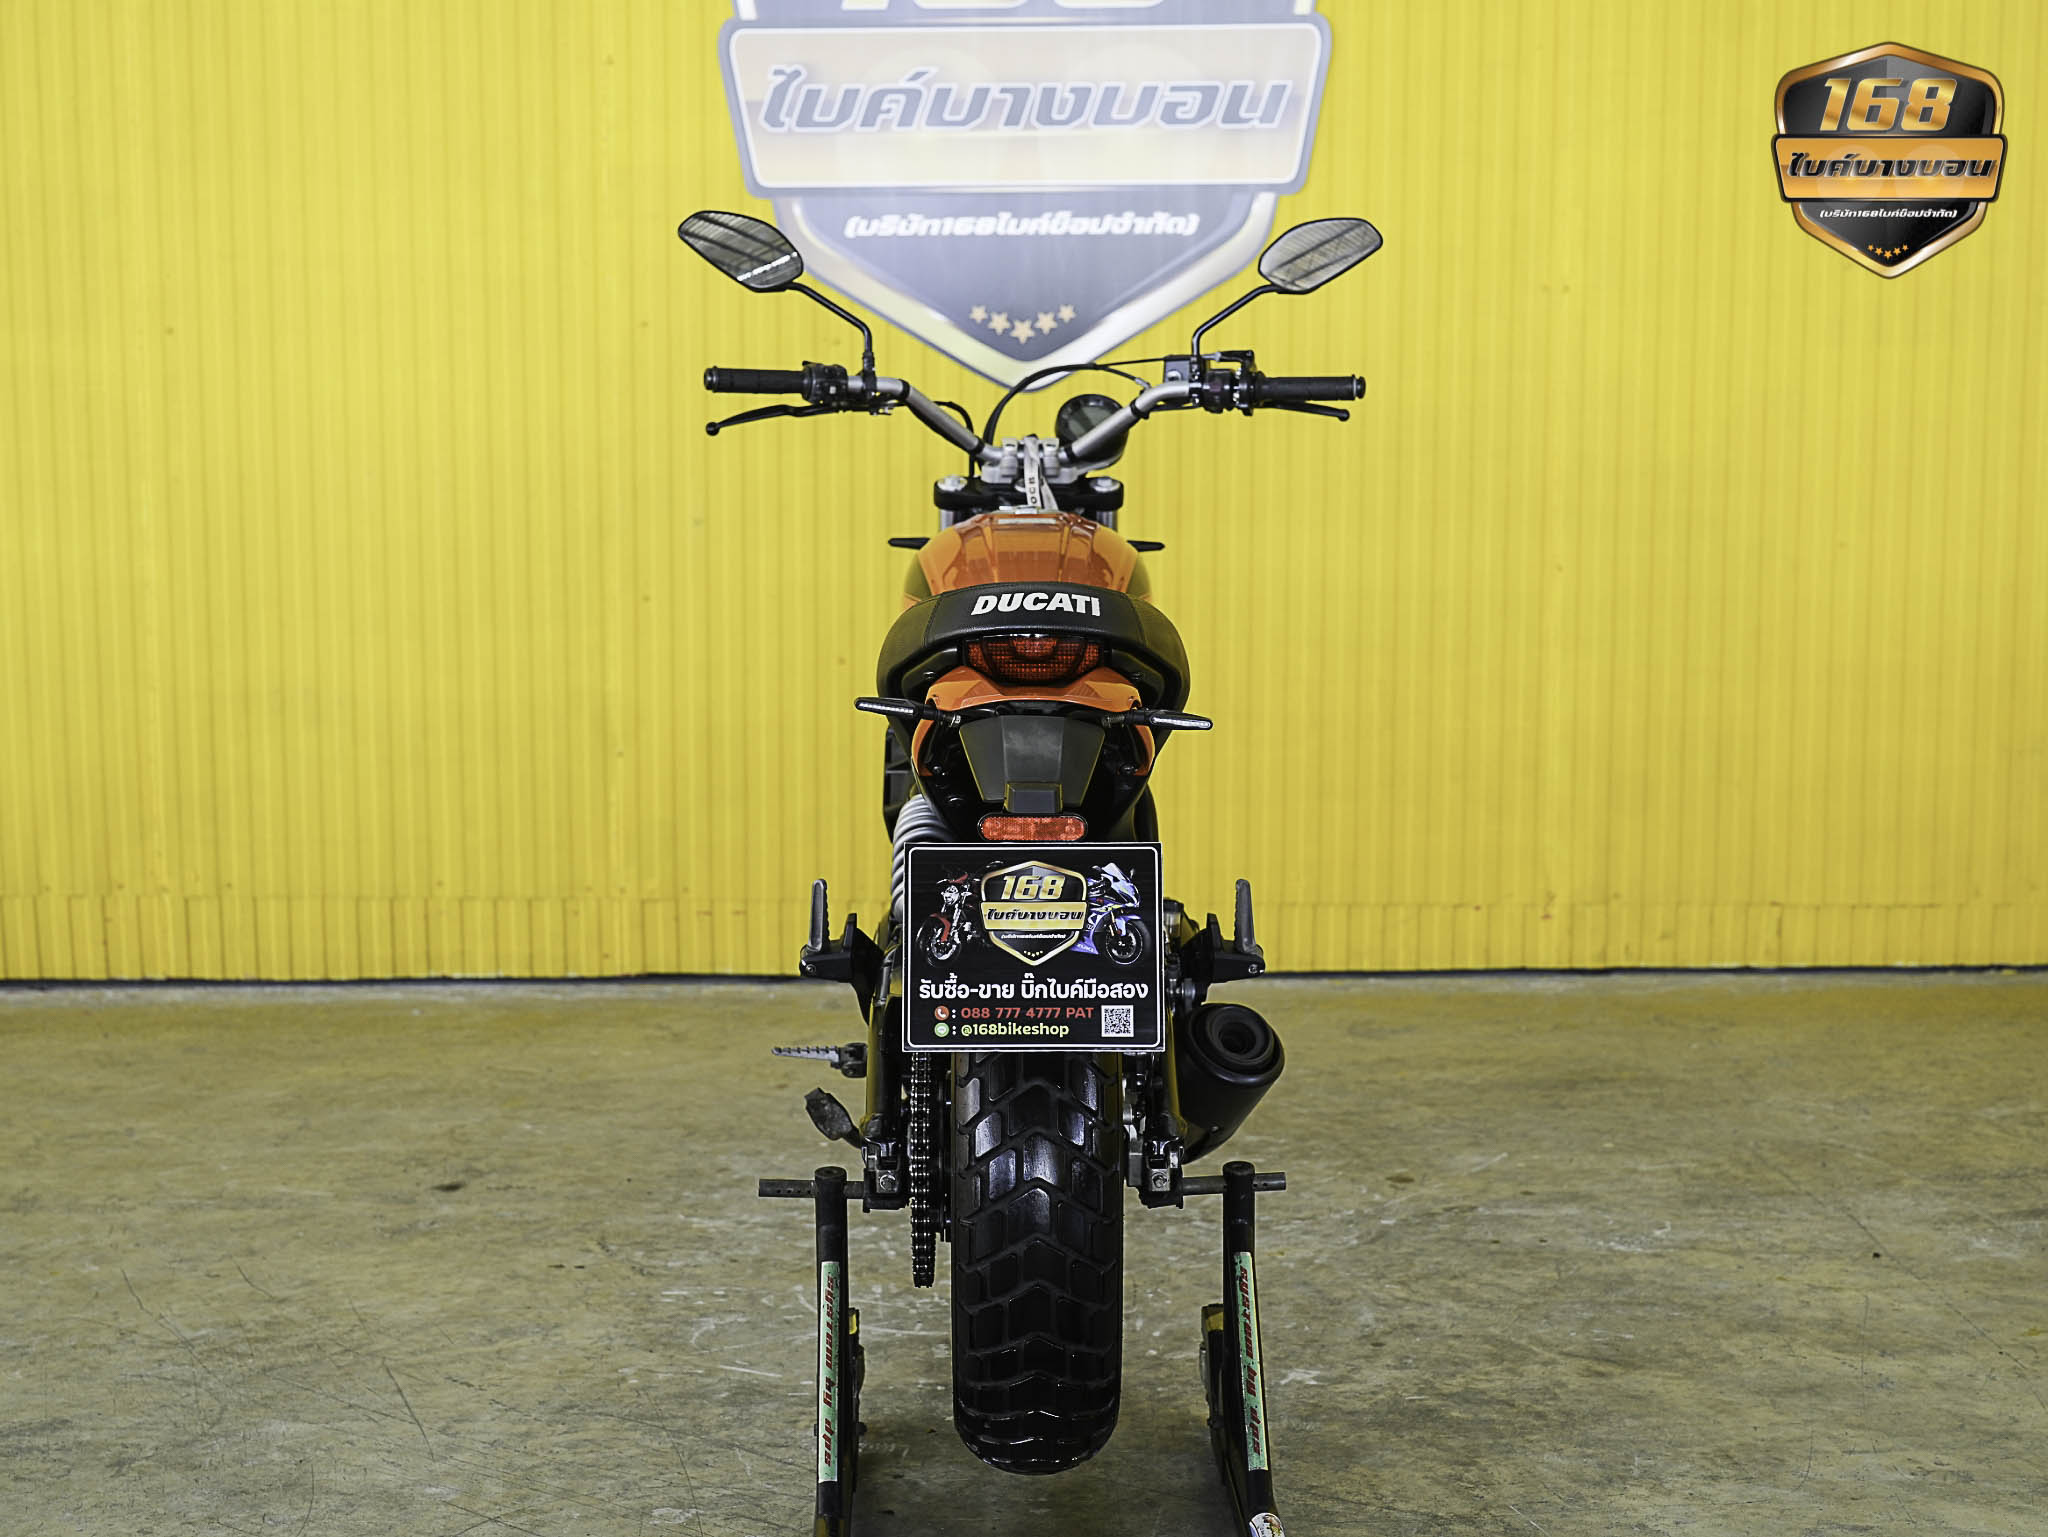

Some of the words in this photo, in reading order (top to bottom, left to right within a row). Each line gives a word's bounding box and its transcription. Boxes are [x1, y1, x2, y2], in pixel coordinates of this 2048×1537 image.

[760, 65, 1292, 132] ไบค์บางบอน
[970, 592, 1101, 617] DUCATI
[1000, 875, 1066, 900] 168
[919, 972, 1015, 1000] รับซื้อ-ขาย
[1021, 972, 1149, 1000] บิ๊กไบค์มือสอง
[960, 1007, 991, 1019] 088
[995, 1007, 1021, 1019] 777
[1025, 1007, 1061, 1019] 4777
[1065, 1007, 1095, 1019] PAT
[961, 1022, 1070, 1038] @168bikeshop
